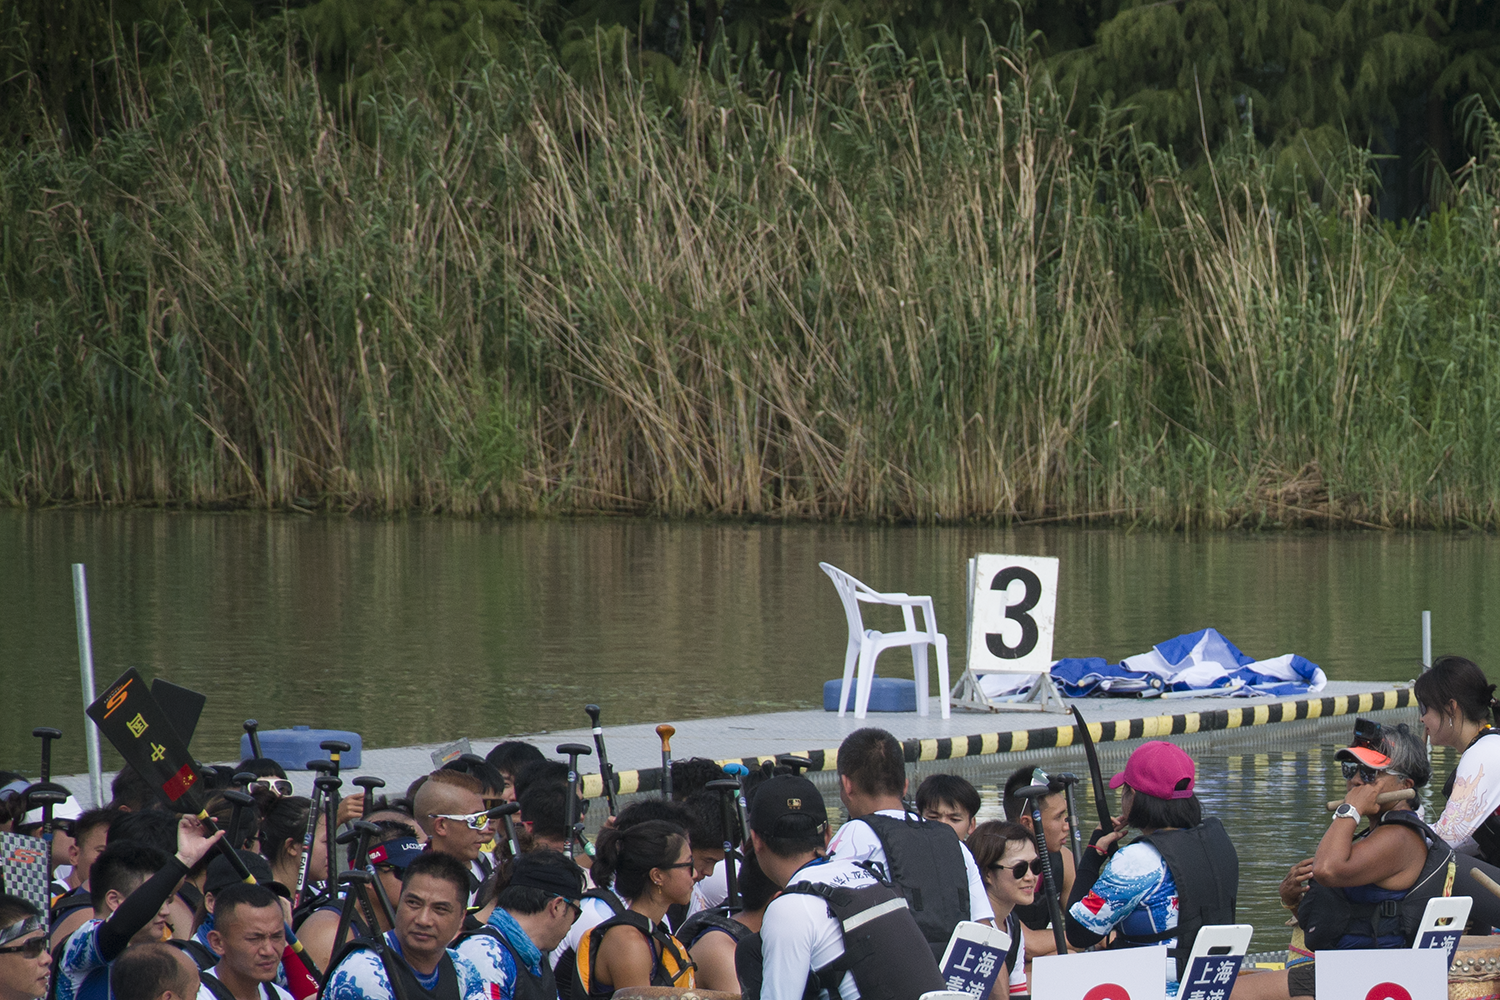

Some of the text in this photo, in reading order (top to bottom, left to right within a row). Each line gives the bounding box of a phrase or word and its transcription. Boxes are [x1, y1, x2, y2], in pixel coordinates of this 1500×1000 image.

[985, 566, 1042, 660] 3
[953, 946, 998, 979] 上海
[1193, 960, 1235, 985] 上海
